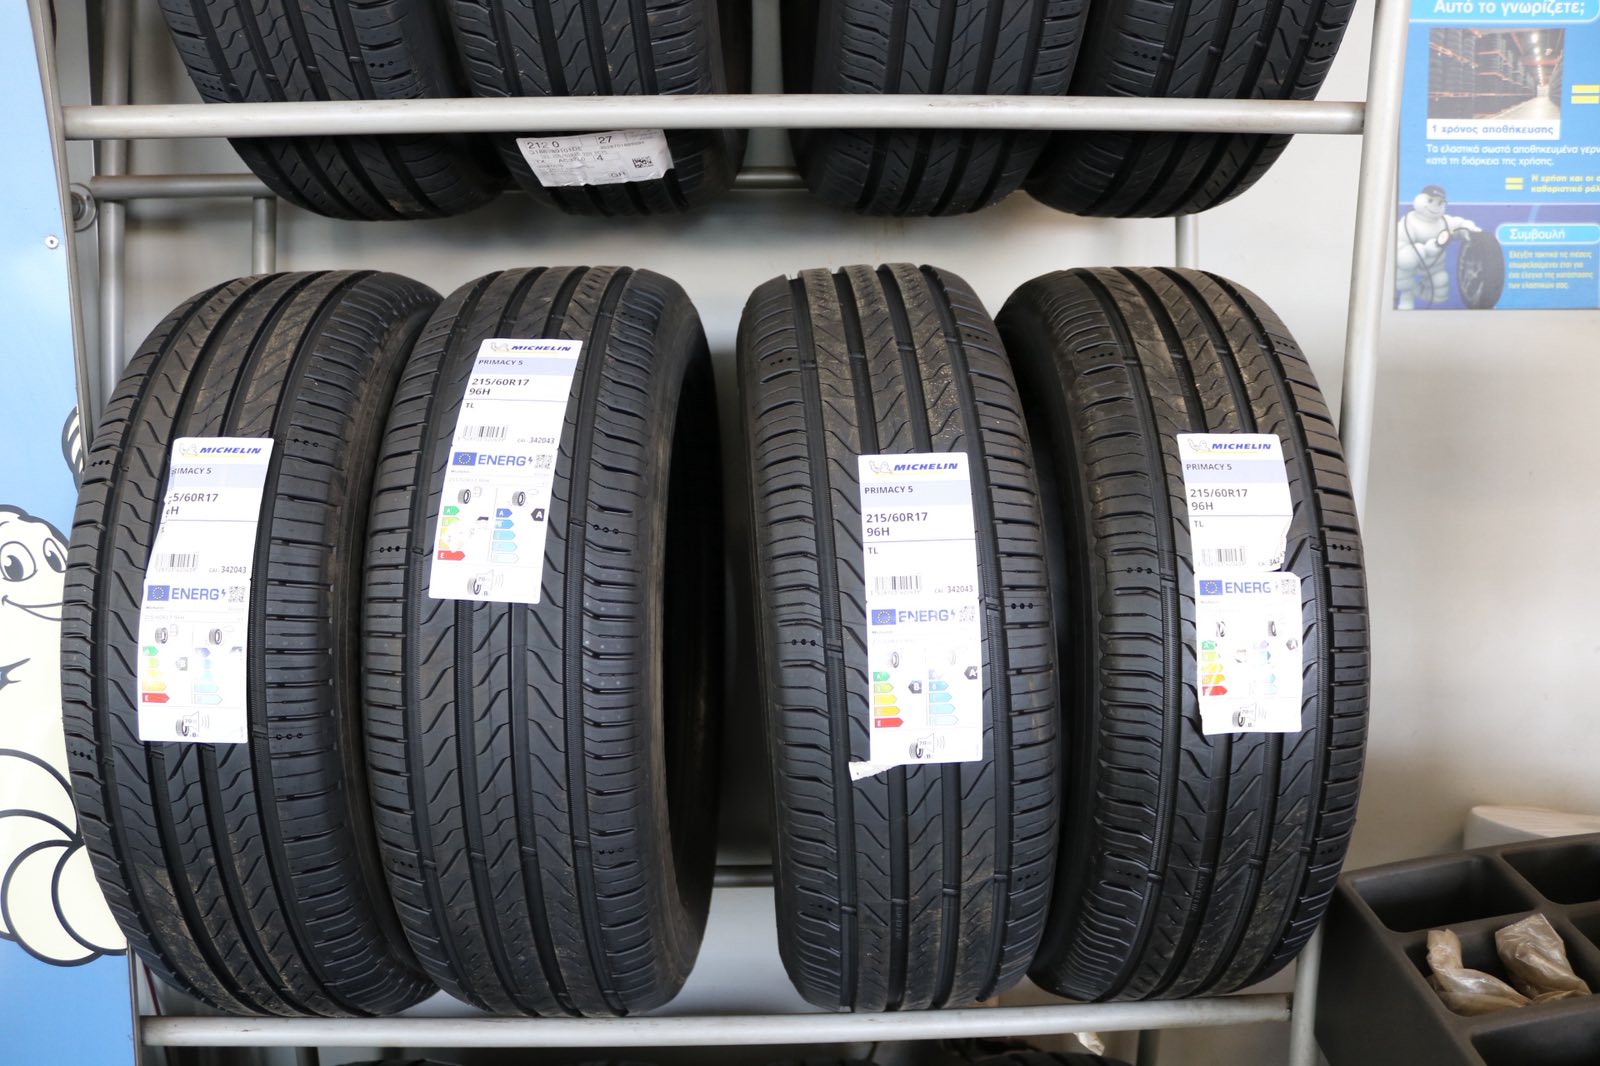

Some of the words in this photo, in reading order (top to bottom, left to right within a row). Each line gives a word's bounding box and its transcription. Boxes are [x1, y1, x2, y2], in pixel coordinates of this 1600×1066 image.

[1433, 0, 1473, 14] Αυτό
[1479, 2, 1497, 14] το
[1501, 0, 1585, 17] γνωρίζετε;
[1431, 125, 1437, 133] 1
[1441, 123, 1478, 135] χρόνος
[1482, 123, 1554, 135] αποθήκευσης
[598, 135, 613, 144] 27
[526, 141, 548, 150] 212
[1509, 228, 1566, 240] Συμβουλή
[471, 378, 530, 386] 215/60R17
[469, 388, 490, 396] 96H
[477, 454, 527, 466] ENERG
[206, 467, 212, 475] 5
[894, 463, 958, 471] MICHELIN
[1186, 463, 1225, 471] PRIMACY
[864, 486, 905, 494] PRIMACY
[907, 485, 914, 493] 5
[1190, 488, 1248, 498] 215/60R17
[1191, 501, 1214, 510] 96H
[866, 512, 928, 523] 215/60R17
[1193, 520, 1204, 528] TL
[866, 527, 890, 536] 96H
[220, 565, 247, 574] 342043
[946, 584, 974, 594] 342043
[1224, 581, 1272, 594] ENERG
[171, 587, 219, 600] ENERG
[898, 609, 949, 623] ENERG
[969, 668, 977, 676] A
[914, 682, 920, 691] B
